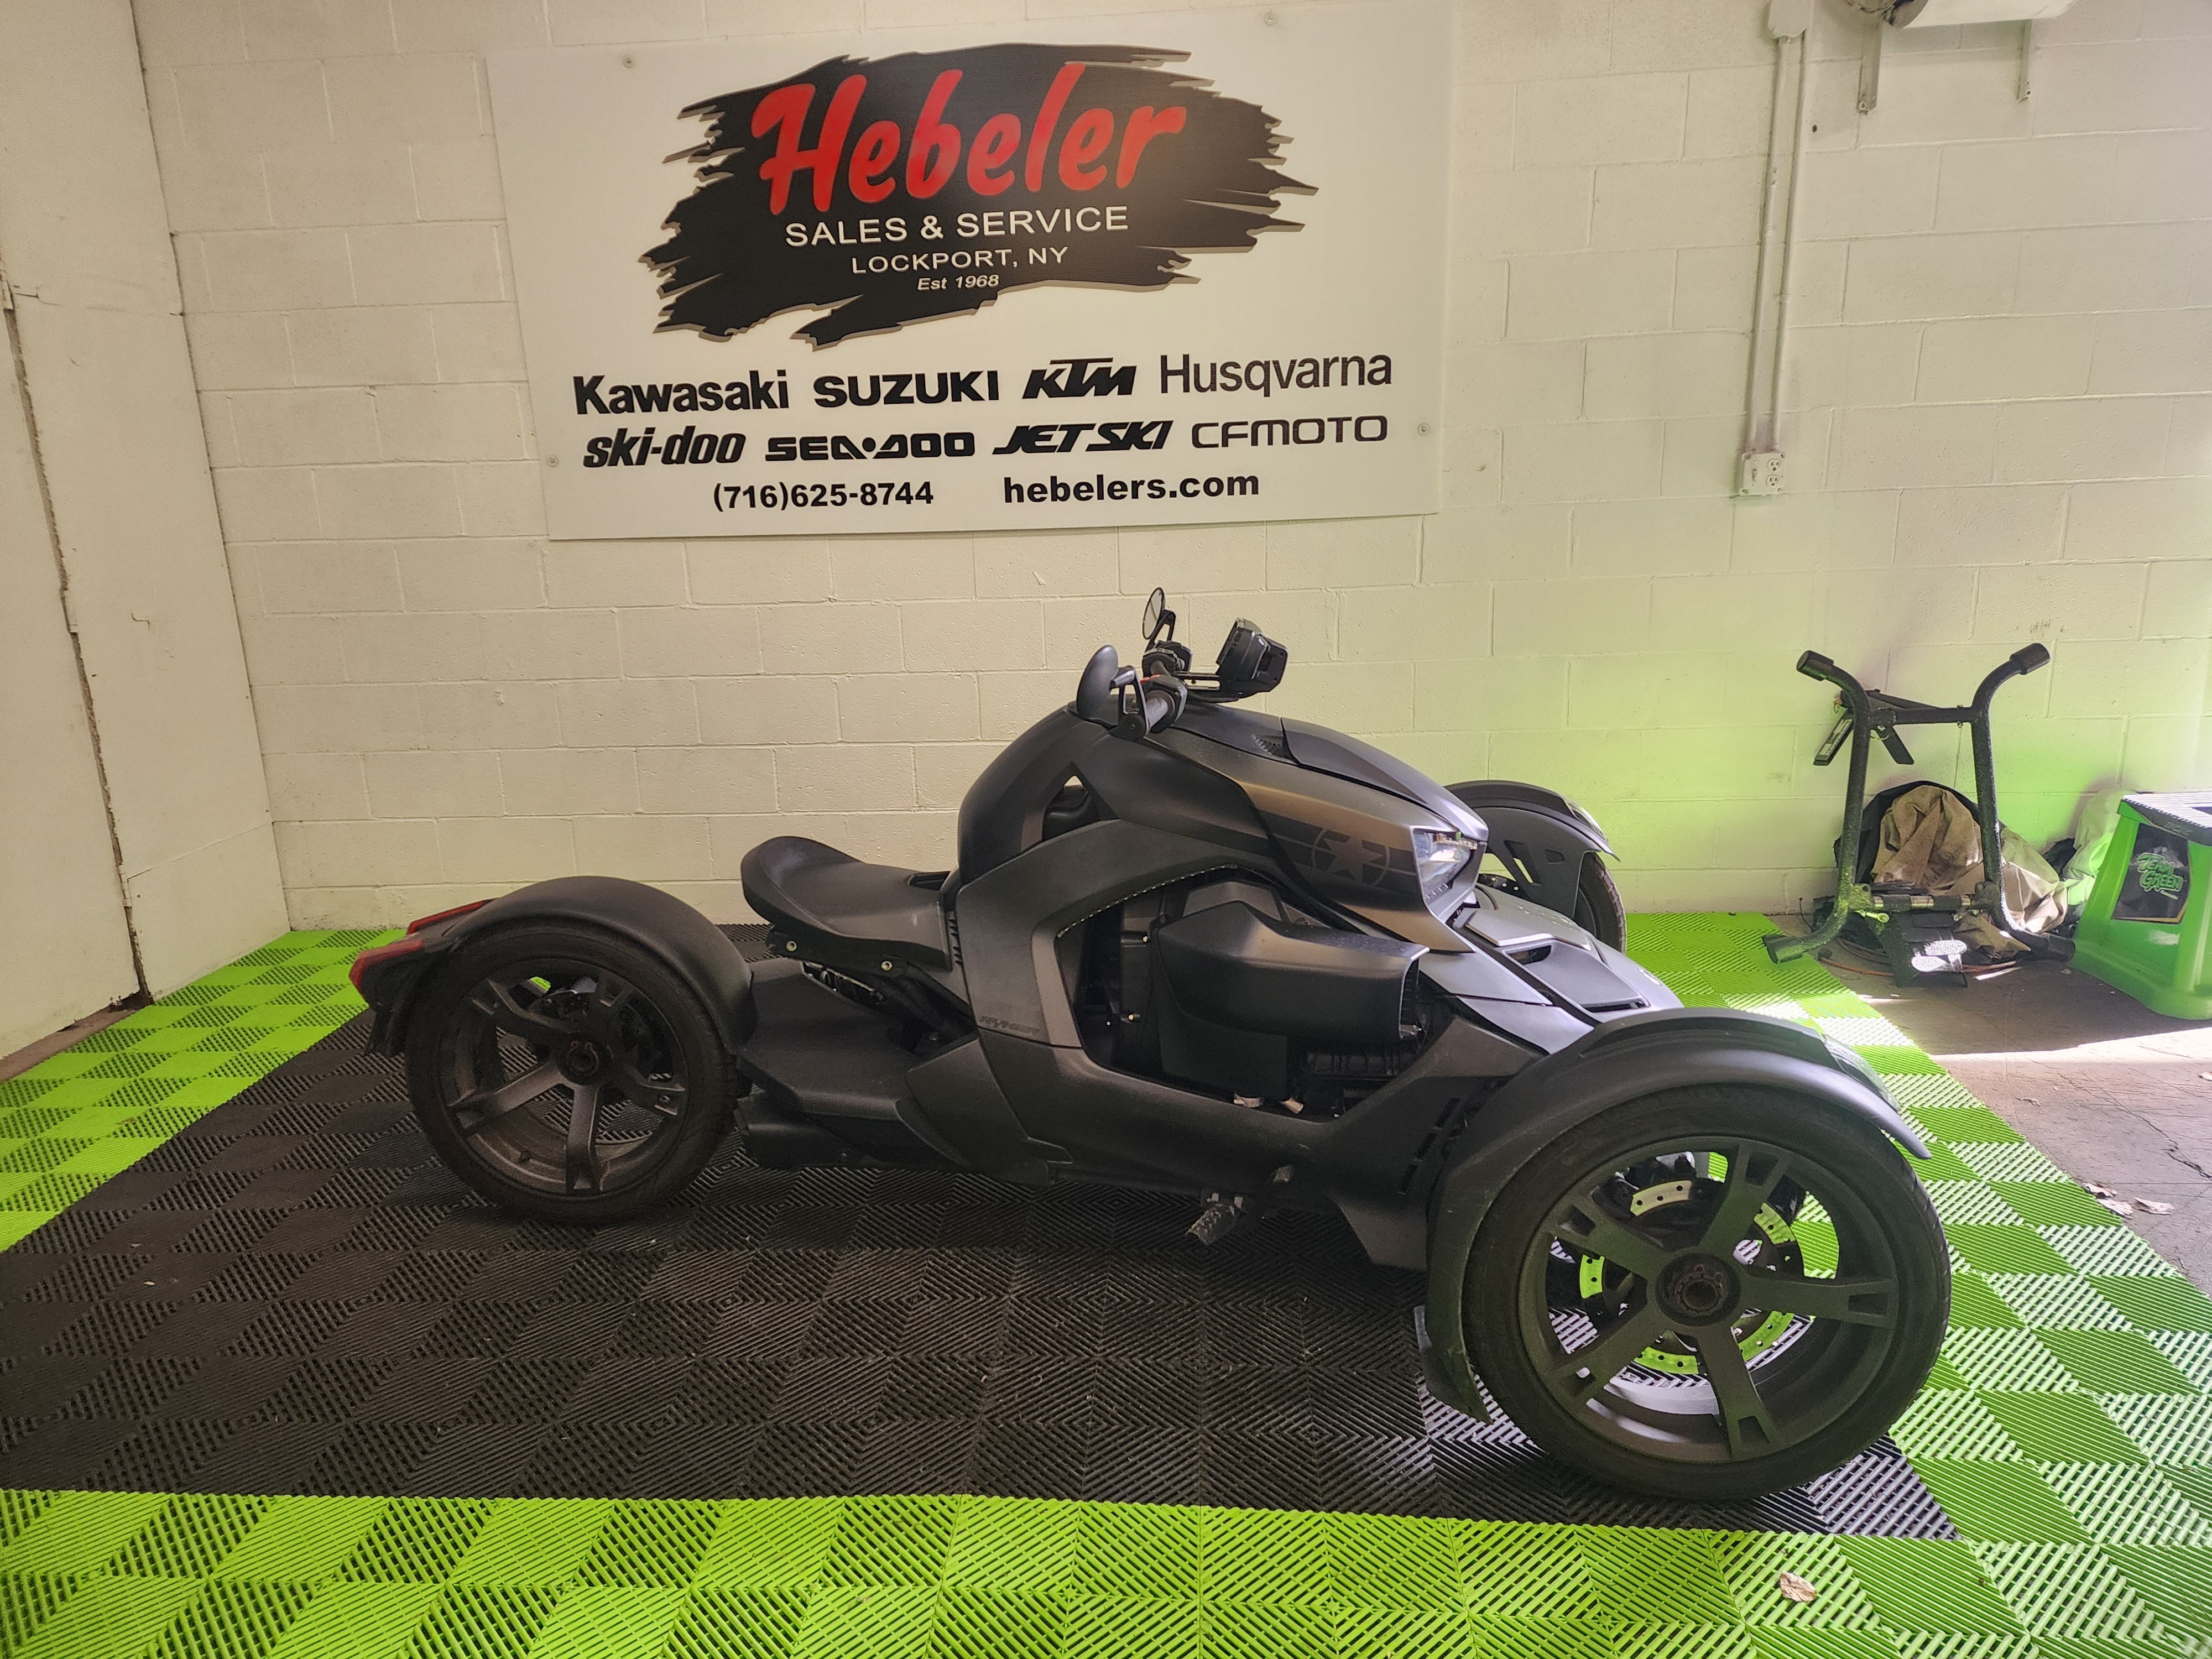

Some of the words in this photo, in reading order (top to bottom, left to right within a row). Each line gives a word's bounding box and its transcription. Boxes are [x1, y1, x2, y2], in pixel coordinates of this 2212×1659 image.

[750, 62, 1187, 216] Hebeler
[785, 217, 907, 247] SALES
[920, 215, 944, 239] &
[956, 206, 1129, 237] SERVICE
[852, 248, 1019, 274] LOCKPORT,
[1028, 246, 1069, 265] NY
[917, 275, 948, 291] Est
[954, 274, 1000, 289] 1968
[573, 369, 789, 415] Kawasaki
[813, 370, 999, 408] SUZUKI
[1021, 357, 1137, 399] KTM
[1160, 354, 1392, 398] Husqvarna
[583, 425, 747, 468] ski-doo
[1192, 415, 1387, 448] CFMOTO
[713, 481, 935, 512] (716)625-8744
[1004, 474, 1259, 503] hebelers.com
[2137, 853, 2174, 875] TEAM
[2140, 870, 2183, 891] GREEN
